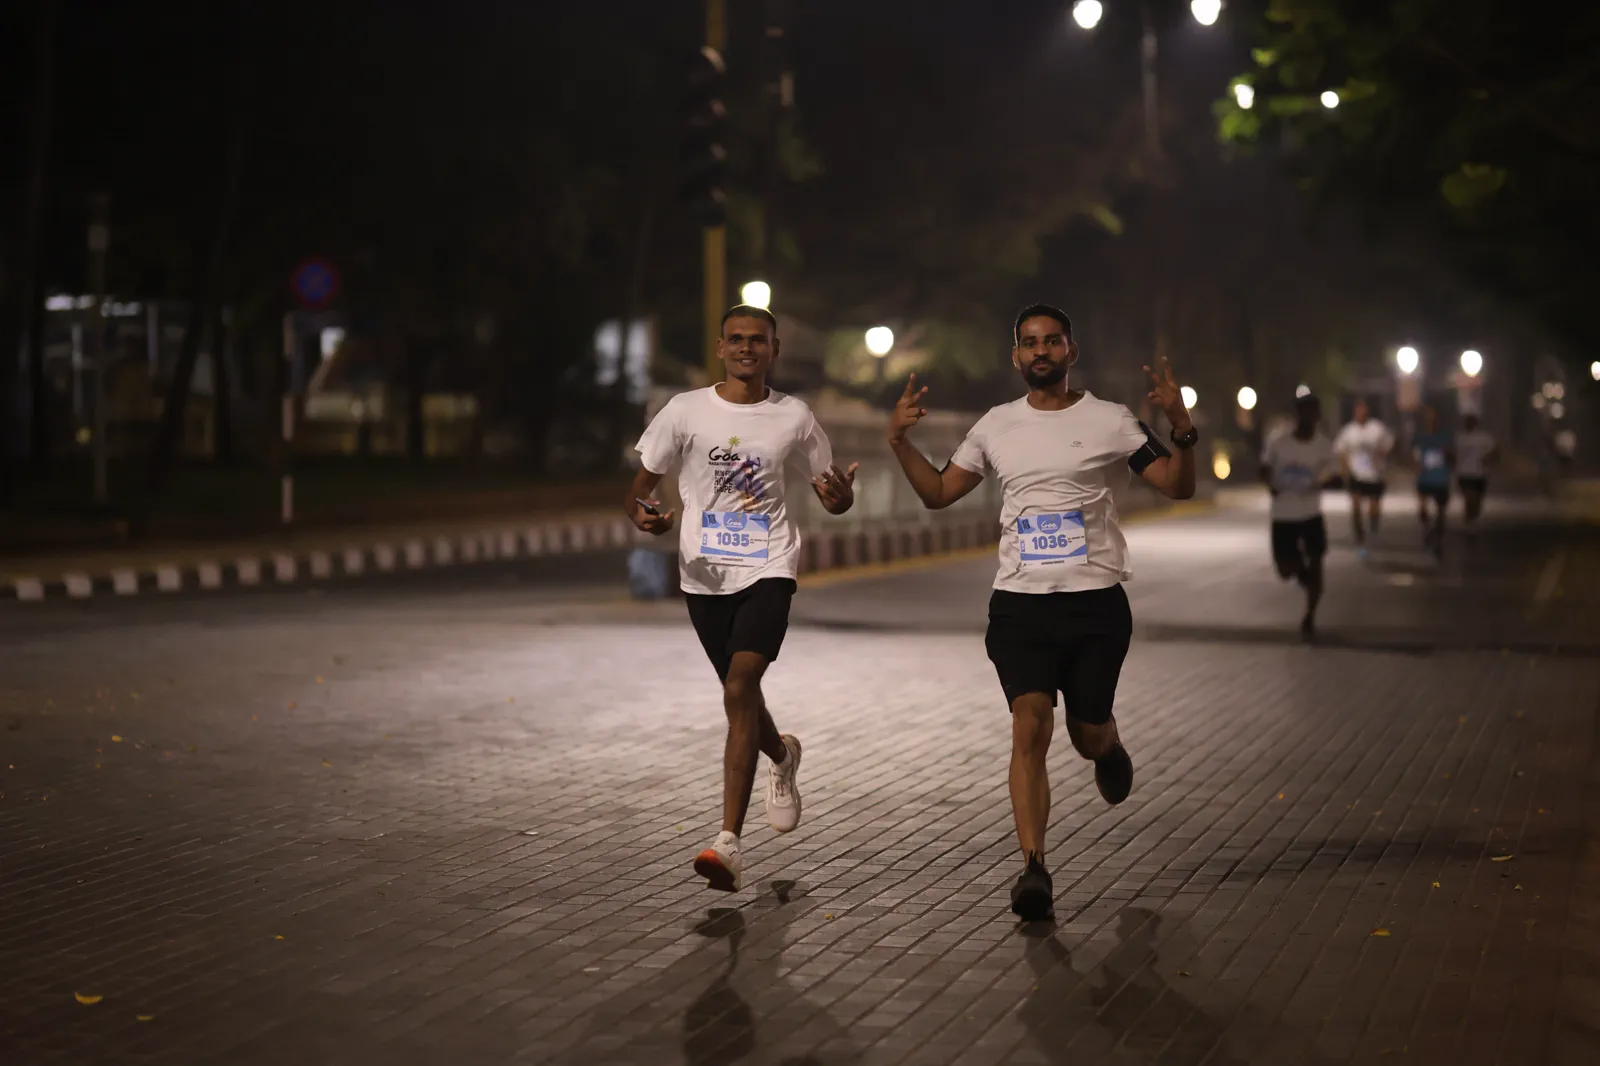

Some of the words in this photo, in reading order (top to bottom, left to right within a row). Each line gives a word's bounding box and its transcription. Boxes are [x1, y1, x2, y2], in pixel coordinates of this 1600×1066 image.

[708, 446, 741, 461] Goa
[1041, 520, 1058, 529] Goa
[716, 532, 750, 547] 1035
[1032, 534, 1068, 550] 1036
